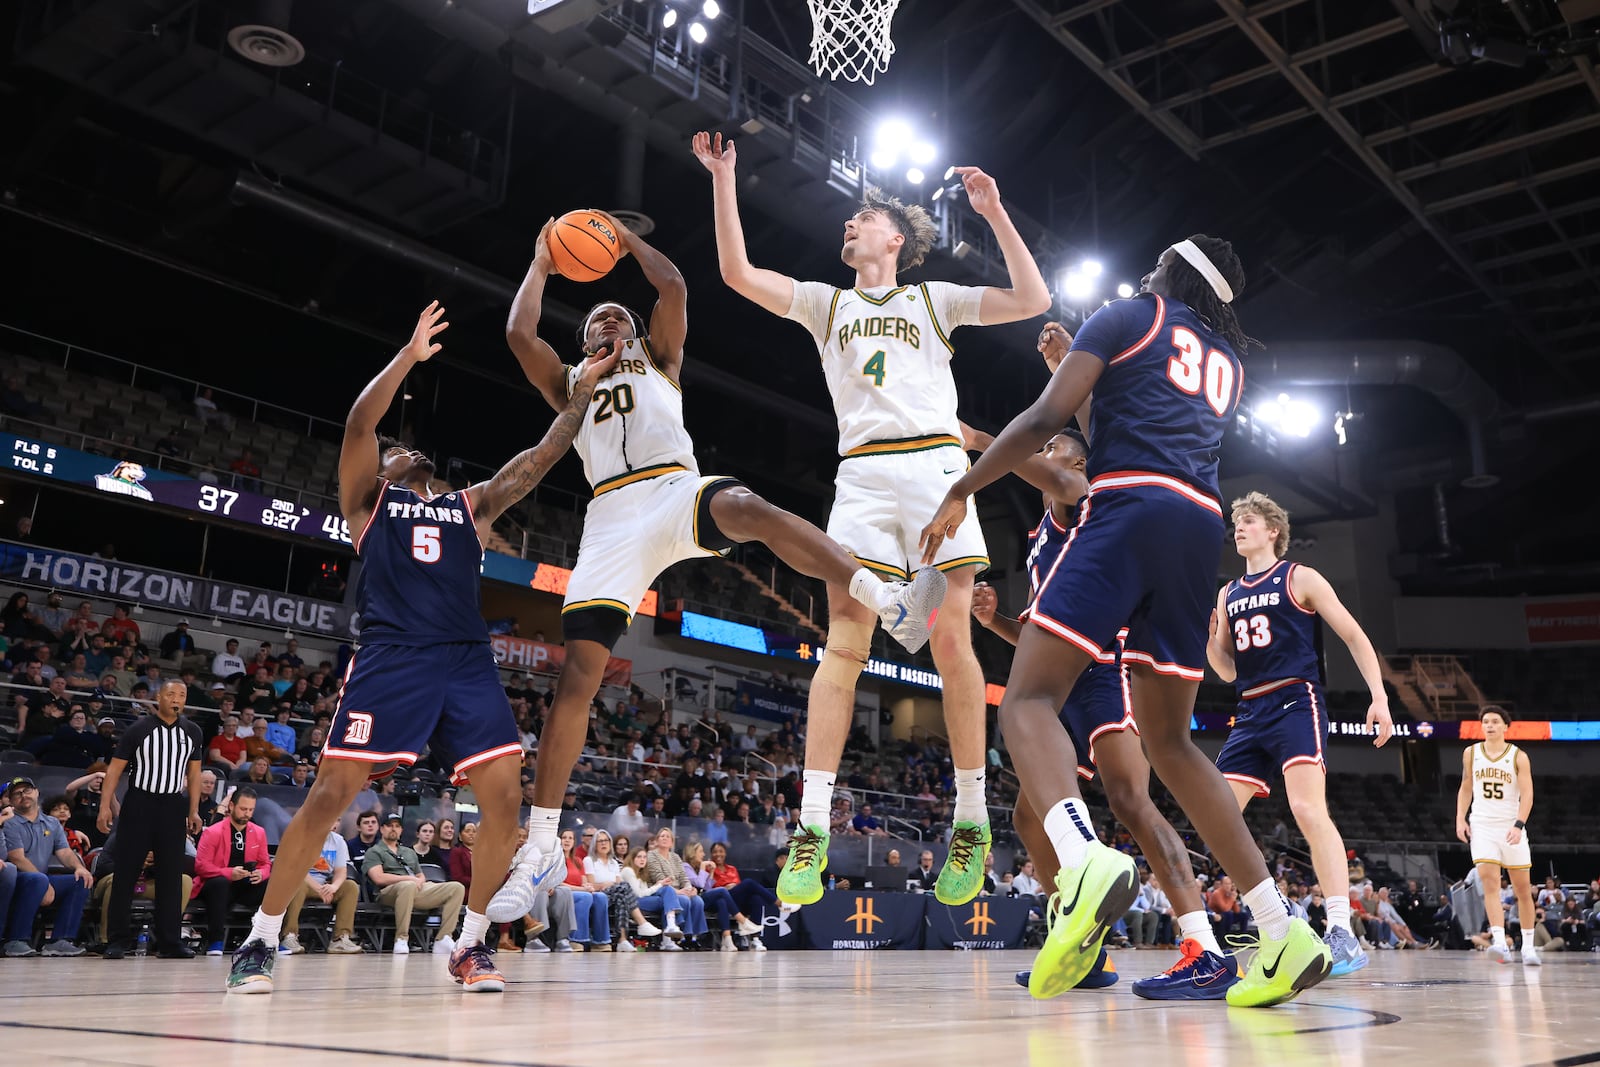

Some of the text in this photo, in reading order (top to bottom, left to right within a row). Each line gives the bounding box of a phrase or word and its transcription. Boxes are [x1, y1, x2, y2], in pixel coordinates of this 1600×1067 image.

[588, 218, 616, 245] NCAA
[838, 316, 921, 352] RAIDERS
[862, 349, 886, 387] 4
[1166, 324, 1235, 417] 30
[592, 382, 635, 425] 20
[14, 439, 57, 459] FLS 5
[12, 455, 54, 474] TOL 2
[198, 484, 240, 515] 37
[271, 498, 295, 514] 2ND
[261, 508, 301, 531] 9:27
[387, 501, 464, 525] TITANS
[412, 524, 442, 564] 5
[21, 551, 194, 607] HORIZON
[209, 585, 337, 632] LEAGUE
[1227, 592, 1280, 618] TITANS
[1234, 613, 1273, 653] 33
[900, 667, 943, 689] BASKETBA
[1341, 722, 1411, 736] BASTALL
[1474, 767, 1514, 784] RAIDERS
[1483, 781, 1504, 800] 55
